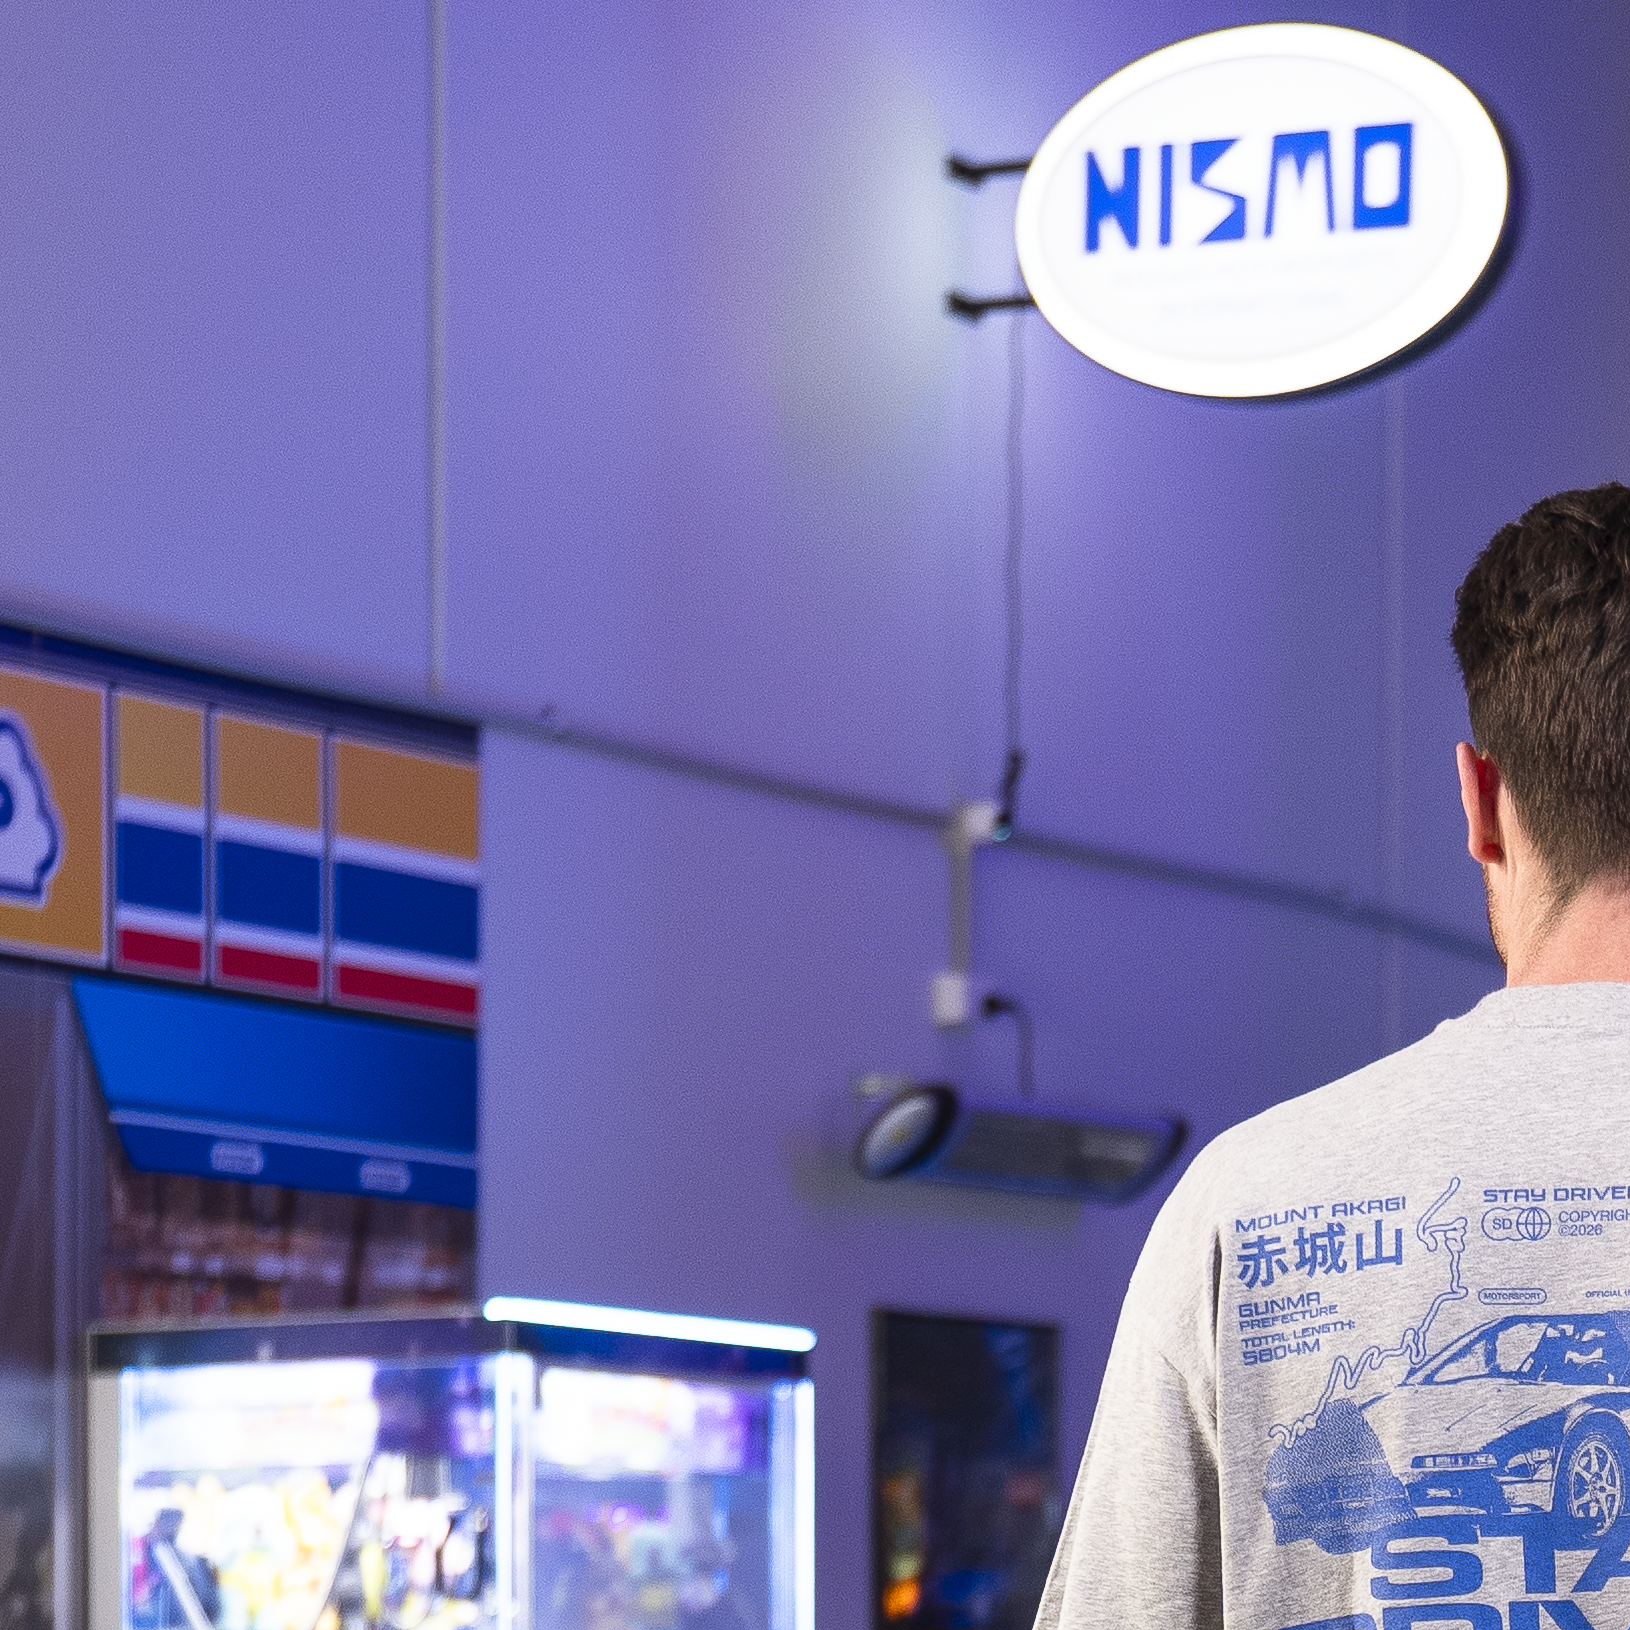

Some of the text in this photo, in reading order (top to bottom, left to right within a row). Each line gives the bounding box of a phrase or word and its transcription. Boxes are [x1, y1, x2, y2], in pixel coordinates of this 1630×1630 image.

[1082, 121, 1415, 254] NISMO
[1482, 1188, 1546, 1203] STAY
[1235, 1196, 1406, 1233] MOUNT AKAGI
[1492, 1218, 1512, 1230] SD
[1558, 1224, 1603, 1237] ©2026
[1237, 1219, 1403, 1289] 赤城山
[1238, 1291, 1321, 1318] GUNMA
[1483, 1291, 1541, 1301] MOTORSPORT
[1585, 1289, 1623, 1299] OFFICIAL
[1239, 1304, 1338, 1331] PREFECTURE
[1241, 1320, 1356, 1349] TOTAL LENGTH:
[1242, 1338, 1321, 1366] 5804M
